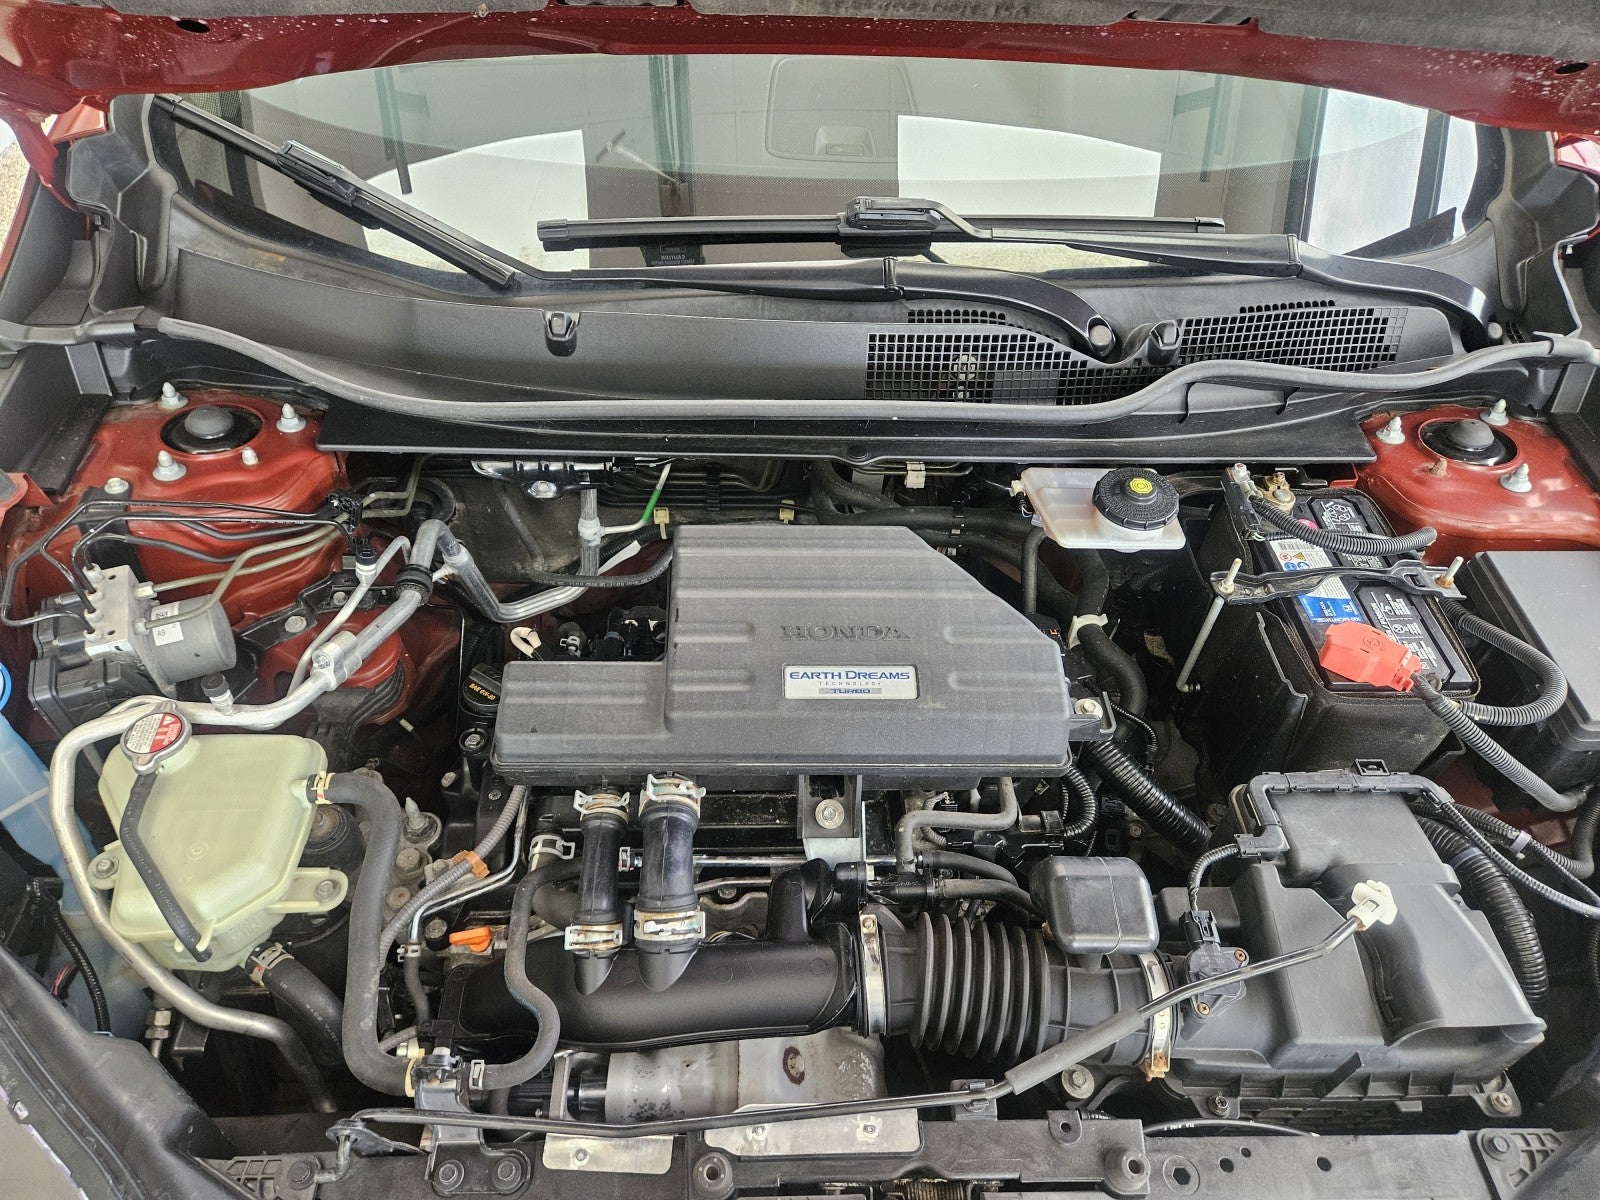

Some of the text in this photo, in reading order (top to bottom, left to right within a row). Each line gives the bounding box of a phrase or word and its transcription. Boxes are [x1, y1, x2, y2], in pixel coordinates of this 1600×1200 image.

[780, 625, 910, 640] HONDA
[789, 670, 910, 680] EARTH DREAMS
